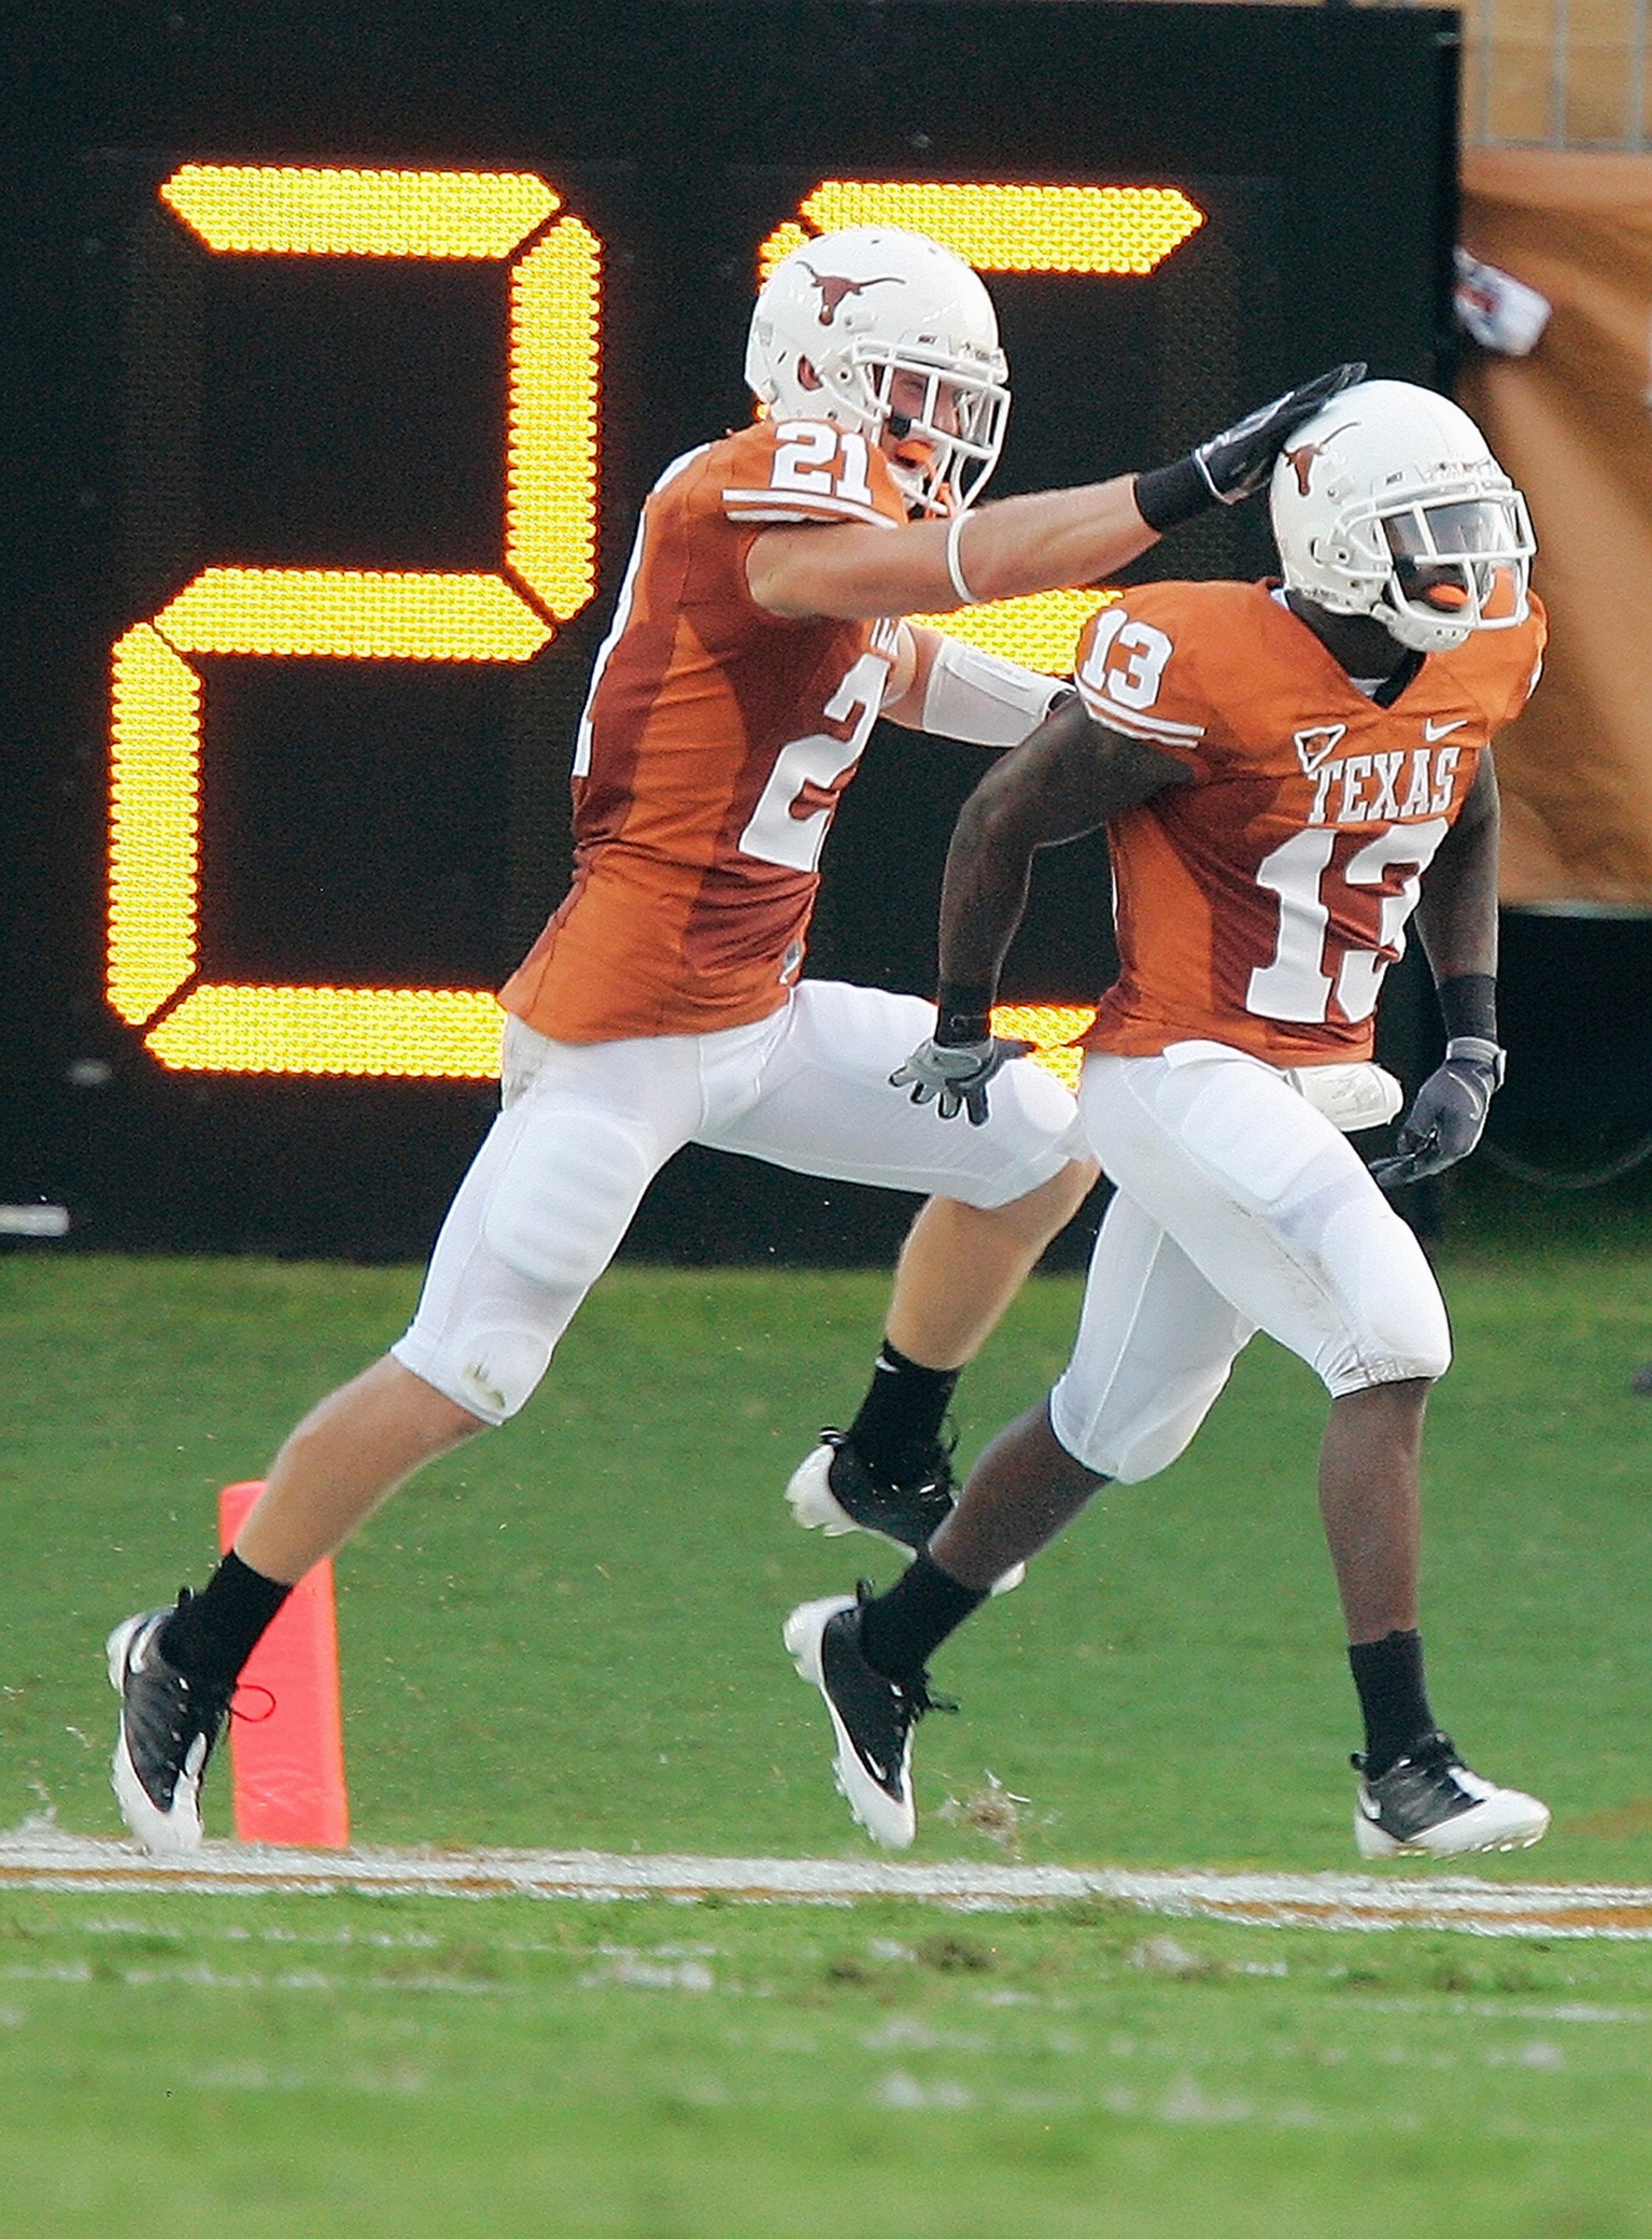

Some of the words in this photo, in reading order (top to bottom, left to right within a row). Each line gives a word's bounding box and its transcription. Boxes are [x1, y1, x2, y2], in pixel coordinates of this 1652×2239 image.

[770, 419, 874, 506] 21
[1080, 608, 1174, 710] 13
[738, 651, 892, 873] 2
[1307, 746, 1461, 825] TEXAS
[1245, 816, 1449, 1023] 13
